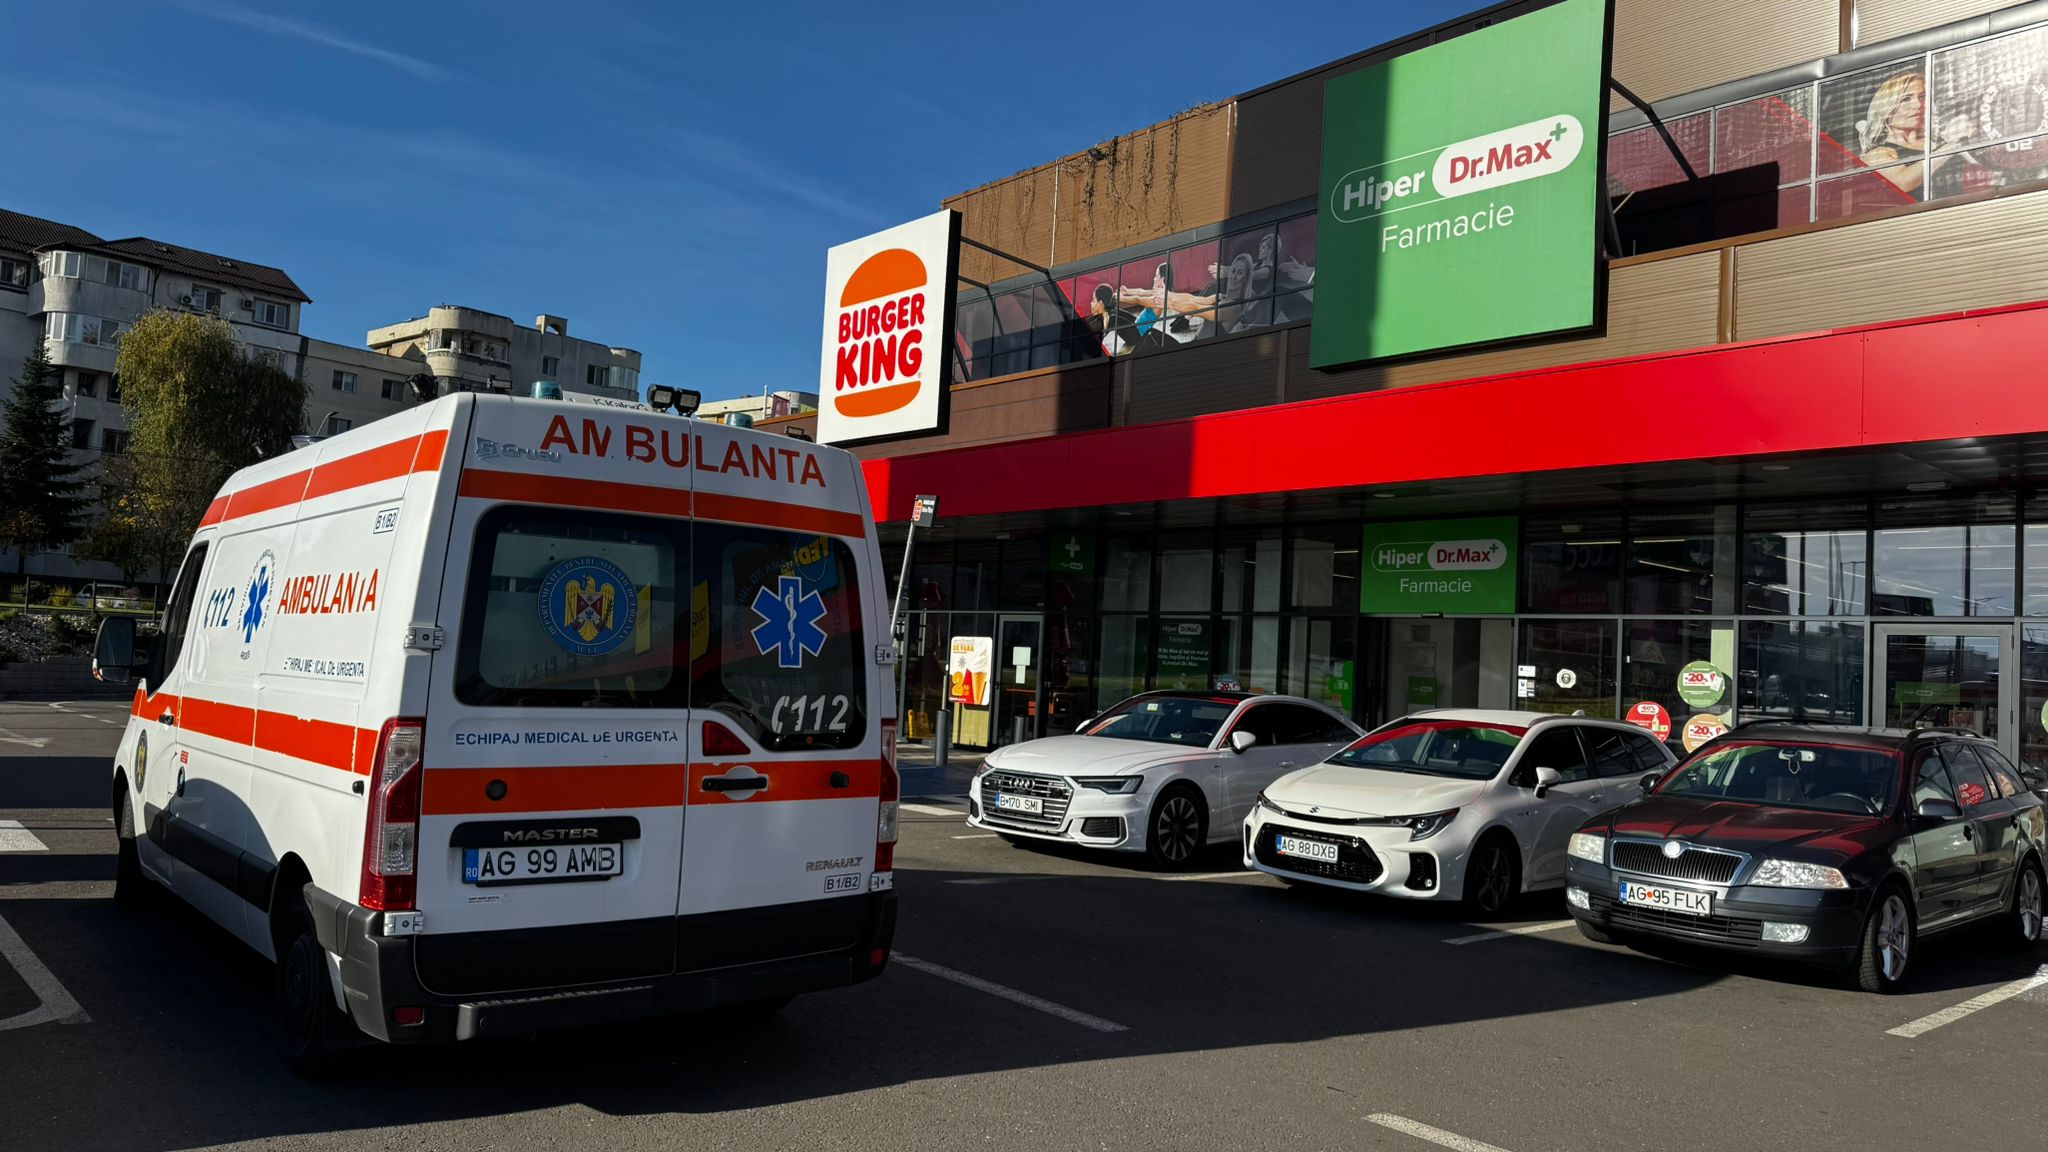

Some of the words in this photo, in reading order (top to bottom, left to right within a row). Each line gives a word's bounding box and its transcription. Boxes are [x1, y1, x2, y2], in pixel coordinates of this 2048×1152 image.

[1343, 168, 1426, 211] Hiper
[1449, 138, 1552, 184] Dr.Max
[1381, 203, 1515, 253] Farmacie
[838, 293, 925, 344] BURGER
[835, 329, 923, 392] KING
[500, 443, 562, 463] Gruau
[1378, 549, 1424, 568] Hiper
[1436, 548, 1491, 563] Dr.Max
[1400, 578, 1472, 593] Farmacie
[210, 587, 236, 628] 112
[952, 671, 964, 696] 2
[791, 694, 850, 732] 112
[455, 733, 520, 746] ECHIPAJ
[524, 732, 589, 745] MEDICAL
[593, 732, 611, 743] DE
[615, 731, 678, 743] URGENTA
[1008, 797, 1021, 809] 170
[1024, 799, 1038, 811] SMI
[503, 827, 600, 842] MASTER
[1282, 837, 1295, 851] AG
[1298, 841, 1311, 855] 88
[1312, 843, 1337, 859] DXB
[465, 867, 478, 878] RO
[481, 851, 516, 877] AG
[528, 848, 557, 874] 99
[566, 846, 615, 873] AMB
[806, 857, 863, 872] RENAULT
[1628, 885, 1647, 901] AG
[1653, 889, 1670, 905] 95
[1674, 892, 1707, 911] FLK
